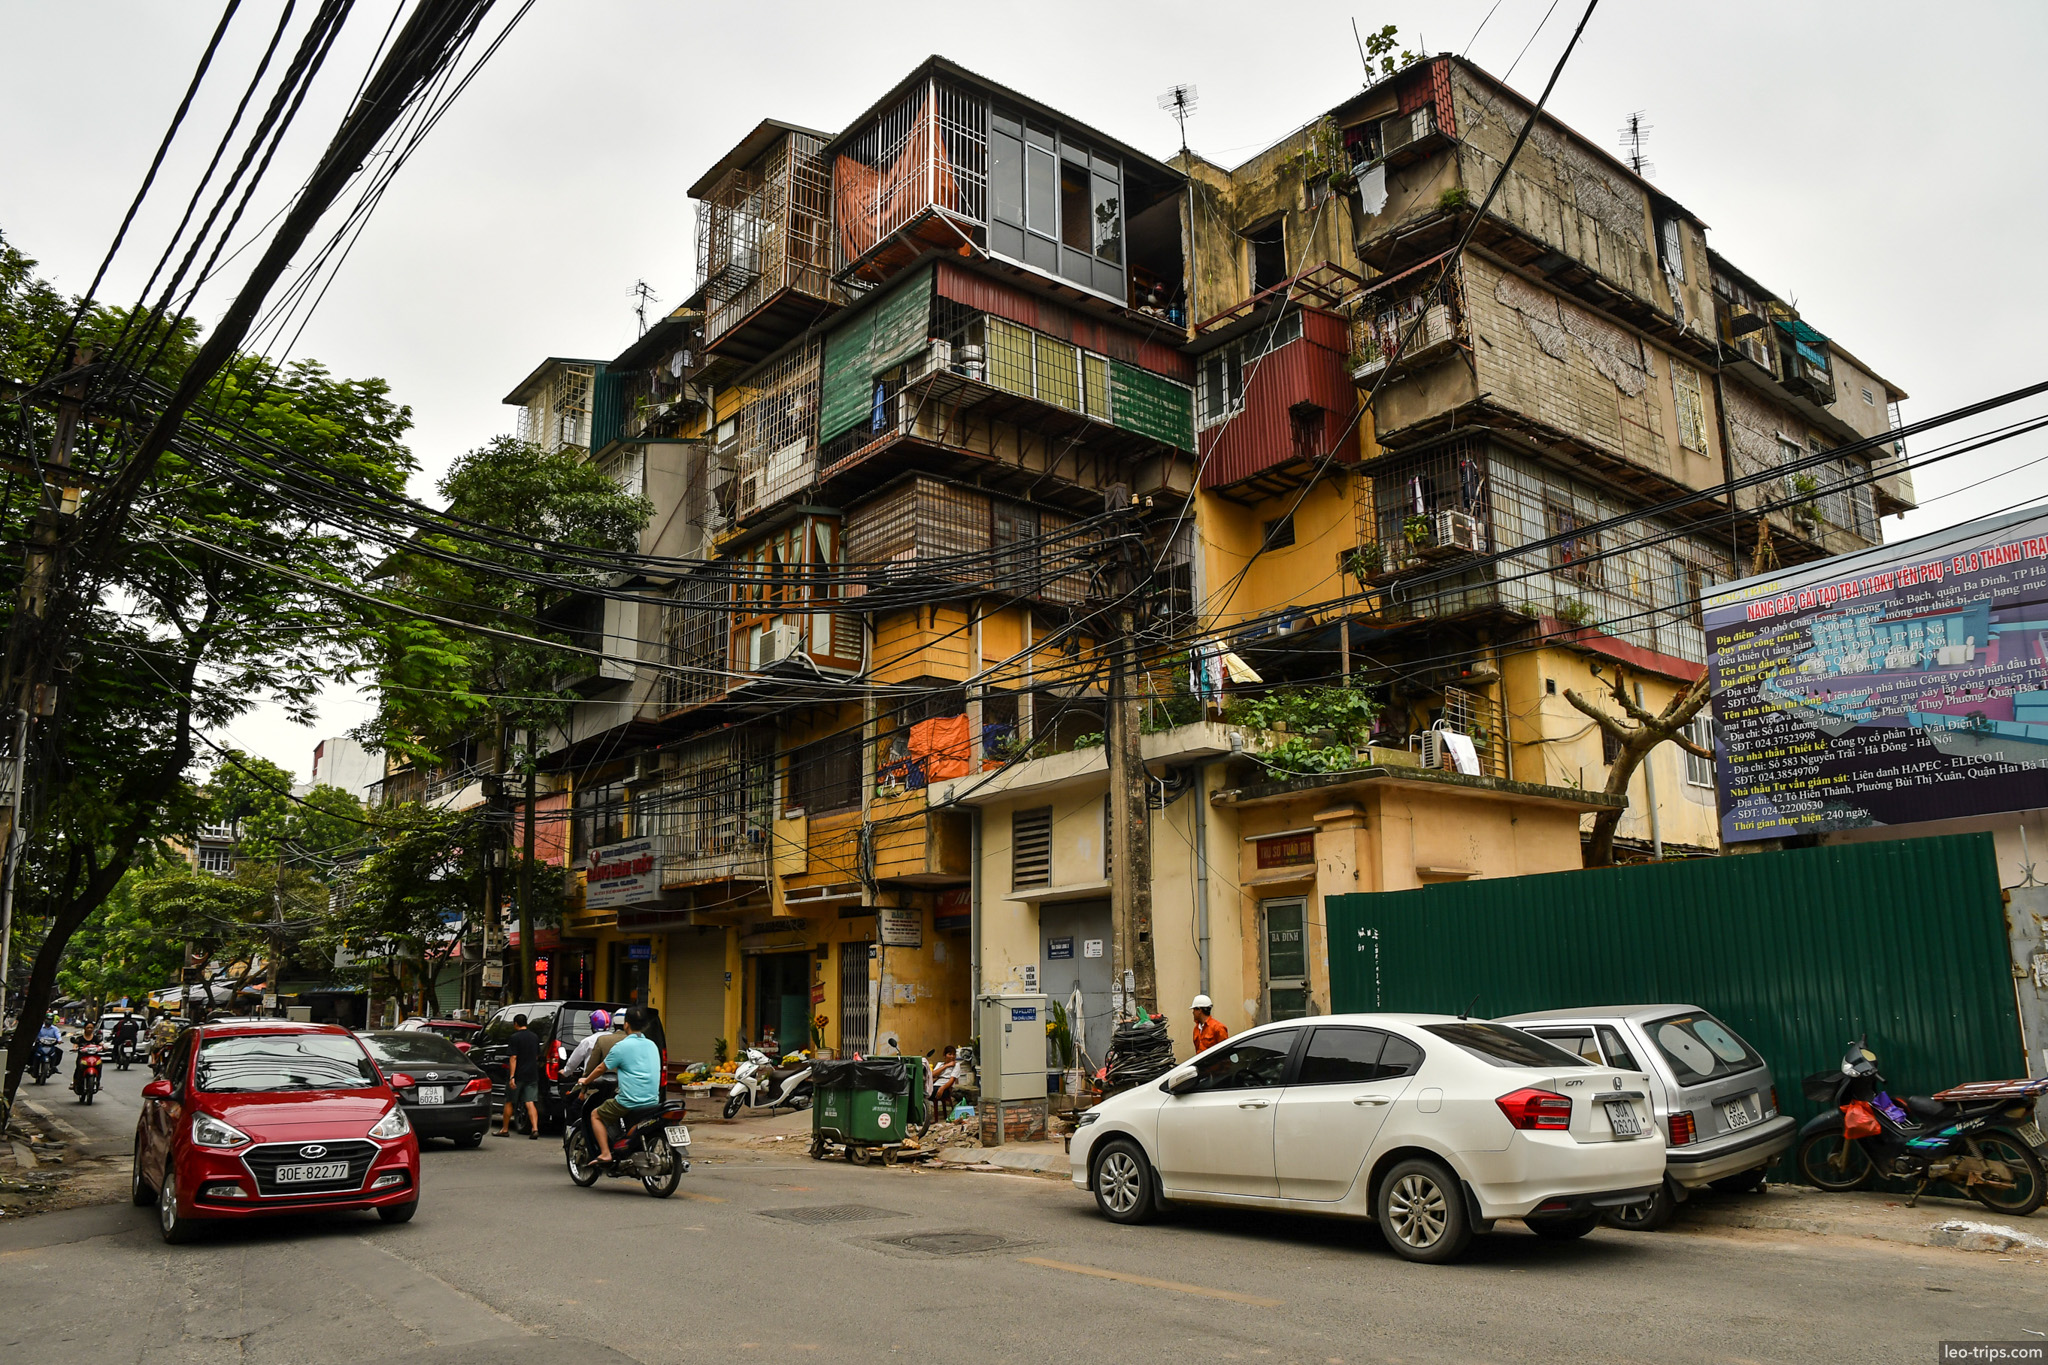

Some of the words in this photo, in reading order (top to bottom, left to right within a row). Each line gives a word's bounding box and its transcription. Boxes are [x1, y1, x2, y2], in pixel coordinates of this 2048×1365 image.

[1746, 600, 1774, 621] NÂNG
[1775, 592, 1797, 613] CẤP,
[1798, 586, 1816, 609] CẢI
[1817, 585, 1837, 606] TẠO
[1839, 580, 1860, 600] TBA
[1861, 572, 1894, 595] 110KV
[1895, 564, 1918, 587] YÊN
[1919, 560, 1944, 582] PHỤ
[1952, 552, 1978, 574] E1.8
[1979, 542, 2020, 568] THÀNH
[1716, 634, 1731, 645] Địa
[1733, 628, 1756, 641] điểm:
[1759, 625, 1769, 635] 50
[1771, 619, 1787, 634] phố
[1789, 617, 1811, 628] Châu
[1845, 603, 1880, 614] Phường
[1884, 597, 1903, 608] Trúc
[1906, 589, 1934, 603] Bạch,
[1936, 586, 1960, 598] quận
[1963, 579, 1977, 591] Ba
[2012, 568, 2027, 580] TP
[2030, 564, 2046, 576] Hà
[1717, 644, 1734, 656] Quy
[1738, 641, 1751, 650] mô
[1915, 603, 1929, 613] trụ
[1932, 596, 1953, 609] thiết
[1957, 594, 1970, 605] bị,
[1973, 591, 1990, 601] các
[1993, 583, 2020, 597] hạng
[2023, 579, 2046, 590] mục
[1719, 667, 1735, 676] Tên
[1758, 657, 1775, 668] đầu
[1894, 631, 1907, 641] TP
[1720, 677, 1735, 687] Đại
[1723, 711, 1739, 720] Tên
[1742, 706, 1759, 716] nhà
[1761, 701, 1781, 713] thầu
[1784, 699, 1797, 709] thi
[1850, 685, 1872, 697] danh
[1876, 682, 1893, 692] nhà
[1895, 676, 1916, 689] thầu
[1949, 671, 1959, 680] ty
[1978, 660, 2003, 676] phần
[2006, 656, 2026, 669] đầu
[2030, 656, 2041, 665] tư
[1726, 687, 1741, 697] Địa
[1724, 720, 1739, 731] mại
[1740, 718, 1756, 727] Tân
[1901, 690, 1918, 700] mại
[1921, 688, 1938, 697] xây
[1959, 680, 1984, 689] công
[1987, 672, 2023, 687] nghiệp
[1727, 697, 1748, 708] SĐT:
[1730, 730, 1744, 741] Địa
[1774, 723, 1788, 733] 431
[1790, 720, 1818, 729] đường
[2018, 680, 2038, 693] Bắc
[1727, 754, 1743, 763] Tên
[1746, 750, 1762, 760] nhà
[1764, 746, 1785, 758] thầu
[1786, 741, 1812, 754] Thiết
[1814, 738, 1828, 750] kế:
[1830, 737, 1855, 747] Công
[1857, 736, 1866, 744] ty
[1868, 729, 1880, 742] cổ
[1882, 726, 1905, 742] phần
[1908, 725, 1922, 736] Tư
[1924, 721, 1945, 733] Vấn
[1948, 719, 1972, 730] Điện
[1976, 716, 1980, 724] 1
[1731, 740, 1753, 752] SĐT:
[1755, 730, 1815, 748] 024.37523998
[1733, 764, 1748, 774] Địa
[1768, 757, 1779, 769] Số
[1782, 757, 1797, 767] 583
[1800, 750, 1835, 765] Nguyễn
[1836, 748, 1855, 758] Trãi
[1864, 744, 1878, 754] Hà
[1880, 742, 1907, 751] Đông
[1916, 736, 1930, 747] Hà
[1933, 734, 1952, 745] Nội
[1730, 786, 1748, 796] Nhà
[1750, 782, 1770, 794] thầu
[1772, 781, 1788, 791] Tư
[1788, 777, 1805, 789] vấn
[1807, 776, 1830, 788] giám
[1832, 773, 1849, 782] sát:
[1852, 770, 1873, 780] Liên
[1876, 766, 1899, 777] danh
[1901, 760, 1941, 773] HAPEC
[1951, 753, 1992, 767] ELECO
[1995, 751, 2004, 760] II
[1734, 774, 1756, 785] SĐT:
[1758, 765, 1819, 781] 024.38549709
[1736, 798, 1752, 808] Địa
[1771, 794, 1782, 802] 42
[1784, 792, 1796, 801] Tô
[1822, 785, 1854, 794] Thành,
[1856, 780, 1892, 790] Phường
[1895, 777, 1912, 787] Bùi
[1914, 774, 1932, 784] Thị
[1934, 770, 1965, 780] Xuân,
[1967, 766, 1996, 780] Quận
[1998, 762, 2017, 773] Hai
[2021, 759, 2036, 770] Bà
[1733, 821, 1754, 830] Thời
[1756, 819, 1775, 830] gian
[1778, 815, 1799, 826] thực
[1801, 813, 1824, 823] hiện:
[1826, 809, 1843, 819] 240
[1845, 807, 1870, 819] ngày.
[1737, 808, 1759, 818] SĐT:
[1761, 800, 1823, 815] 024.22200530
[1272, 933, 1280, 942] BA
[424, 1087, 438, 1095] 29A
[1613, 1102, 1629, 1118] 30A
[1614, 1119, 1640, 1134] 263.21
[278, 1164, 346, 1181] 30E-822.77
